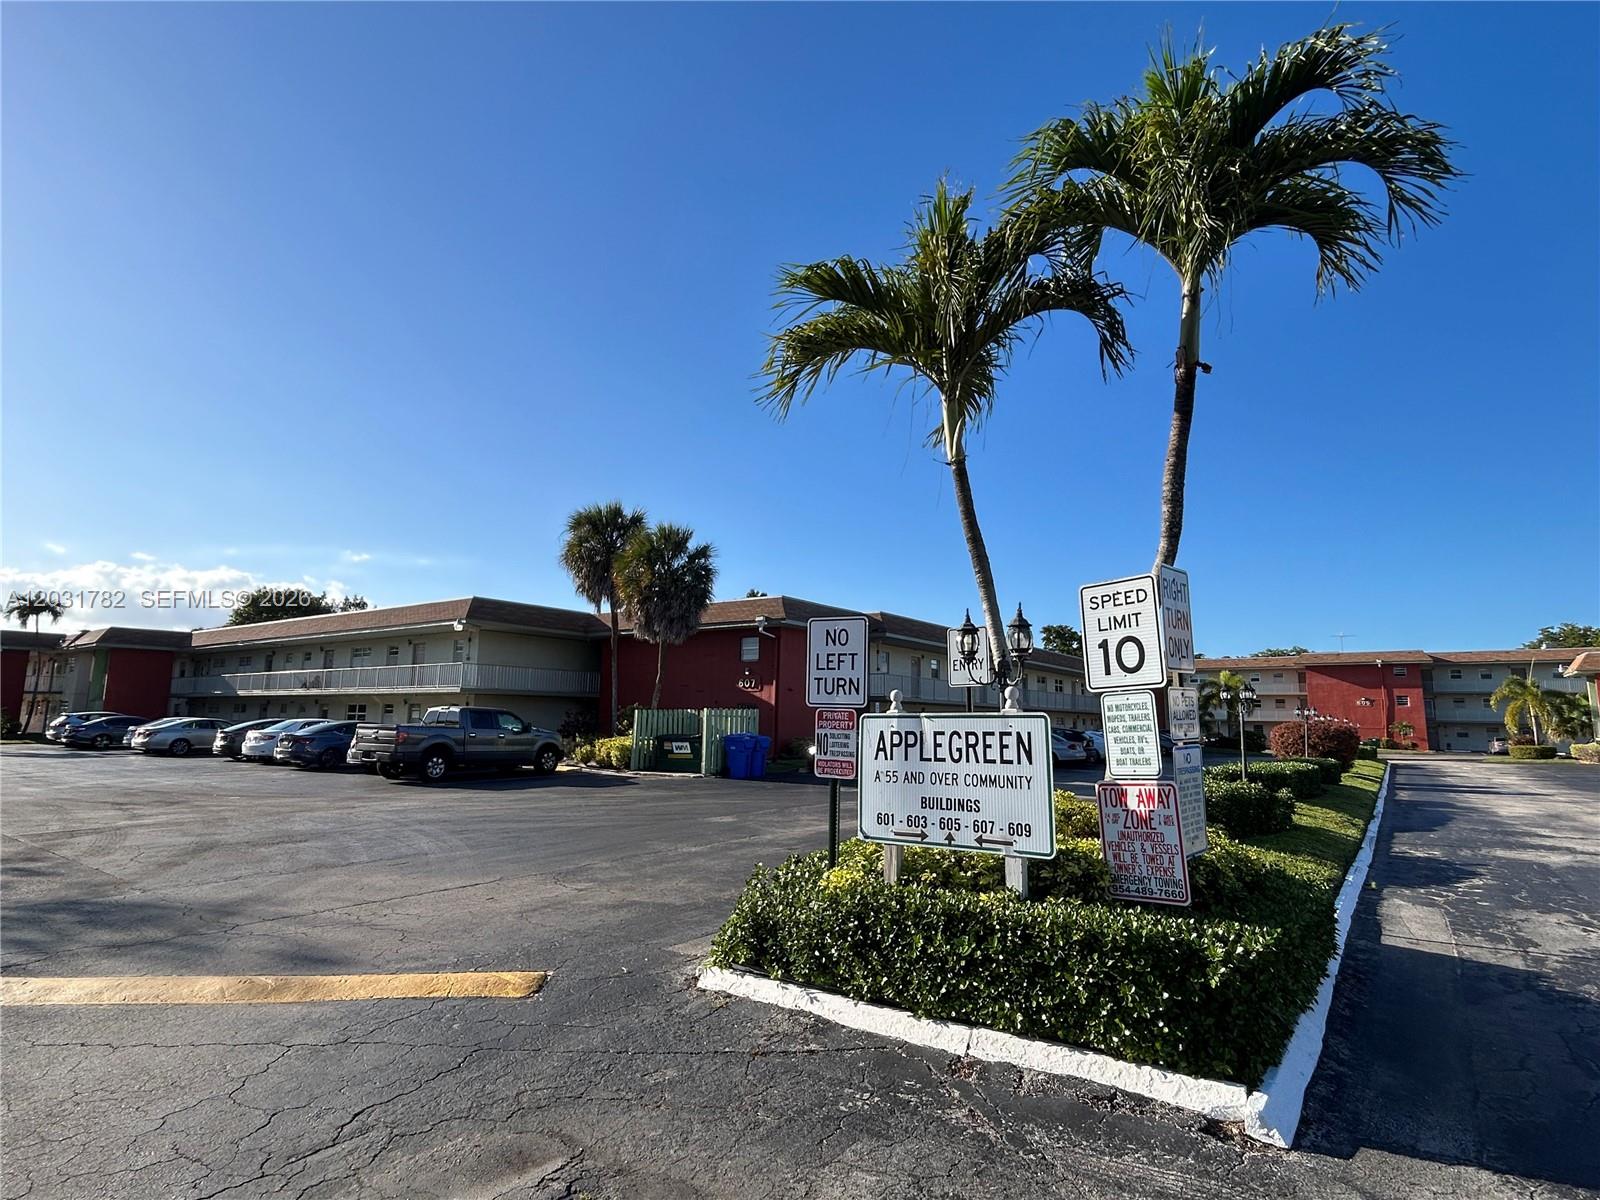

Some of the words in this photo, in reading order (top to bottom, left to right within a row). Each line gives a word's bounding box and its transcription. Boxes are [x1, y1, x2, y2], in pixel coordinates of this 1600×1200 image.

[1089, 588, 1148, 610] SPEED
[1163, 577, 1187, 603] RIGHT
[1098, 612, 1142, 632] LIMIT
[1165, 607, 1190, 631] TURN
[825, 628, 849, 646] NO
[1097, 635, 1146, 676] 10
[1168, 636, 1190, 660] ONLY
[816, 653, 858, 671] LEFT
[952, 658, 984, 671] ENRY
[738, 678, 755, 688] 607
[814, 677, 860, 695] TURN
[822, 711, 849, 720] PRIVATE
[1173, 709, 1197, 720] ALLOWED
[818, 720, 854, 729] PROPERTY
[1122, 723, 1153, 733] COMMERCIAL
[816, 732, 829, 756] NO
[874, 730, 1033, 765] APPLEGREEN
[1115, 758, 1128, 766] BOAT
[1129, 757, 1152, 766] TRAILERS
[874, 770, 881, 783] A
[885, 770, 899, 784] 55
[903, 771, 925, 785] AND
[930, 771, 959, 786] OVER
[964, 773, 1033, 790] COMMUNITY
[920, 796, 981, 813] BUILDINGS
[1101, 787, 1128, 808] TOW
[1137, 787, 1172, 810] AWAY
[876, 812, 895, 827] 601
[906, 814, 928, 829] 603
[939, 816, 961, 832] 605
[973, 819, 995, 834] 607
[1008, 822, 1032, 838] 609
[1121, 808, 1157, 831] ZONE
[1117, 830, 1165, 843] UNAUTHORIZED
[1107, 841, 1136, 852] VEHICLES
[1140, 842, 1146, 853] &
[1150, 843, 1179, 855] VESSELS
[1112, 852, 1128, 863] WILL
[1131, 853, 1139, 864] BE
[1142, 854, 1165, 866] TOWED
[1168, 855, 1176, 867] AT
[1114, 862, 1143, 876] OWNER'S
[1146, 865, 1176, 878] EXPENSE
[1110, 873, 1152, 887] EMERGENCY
[1154, 877, 1184, 890] TOWING
[1112, 884, 1185, 899] 954-489-7660
